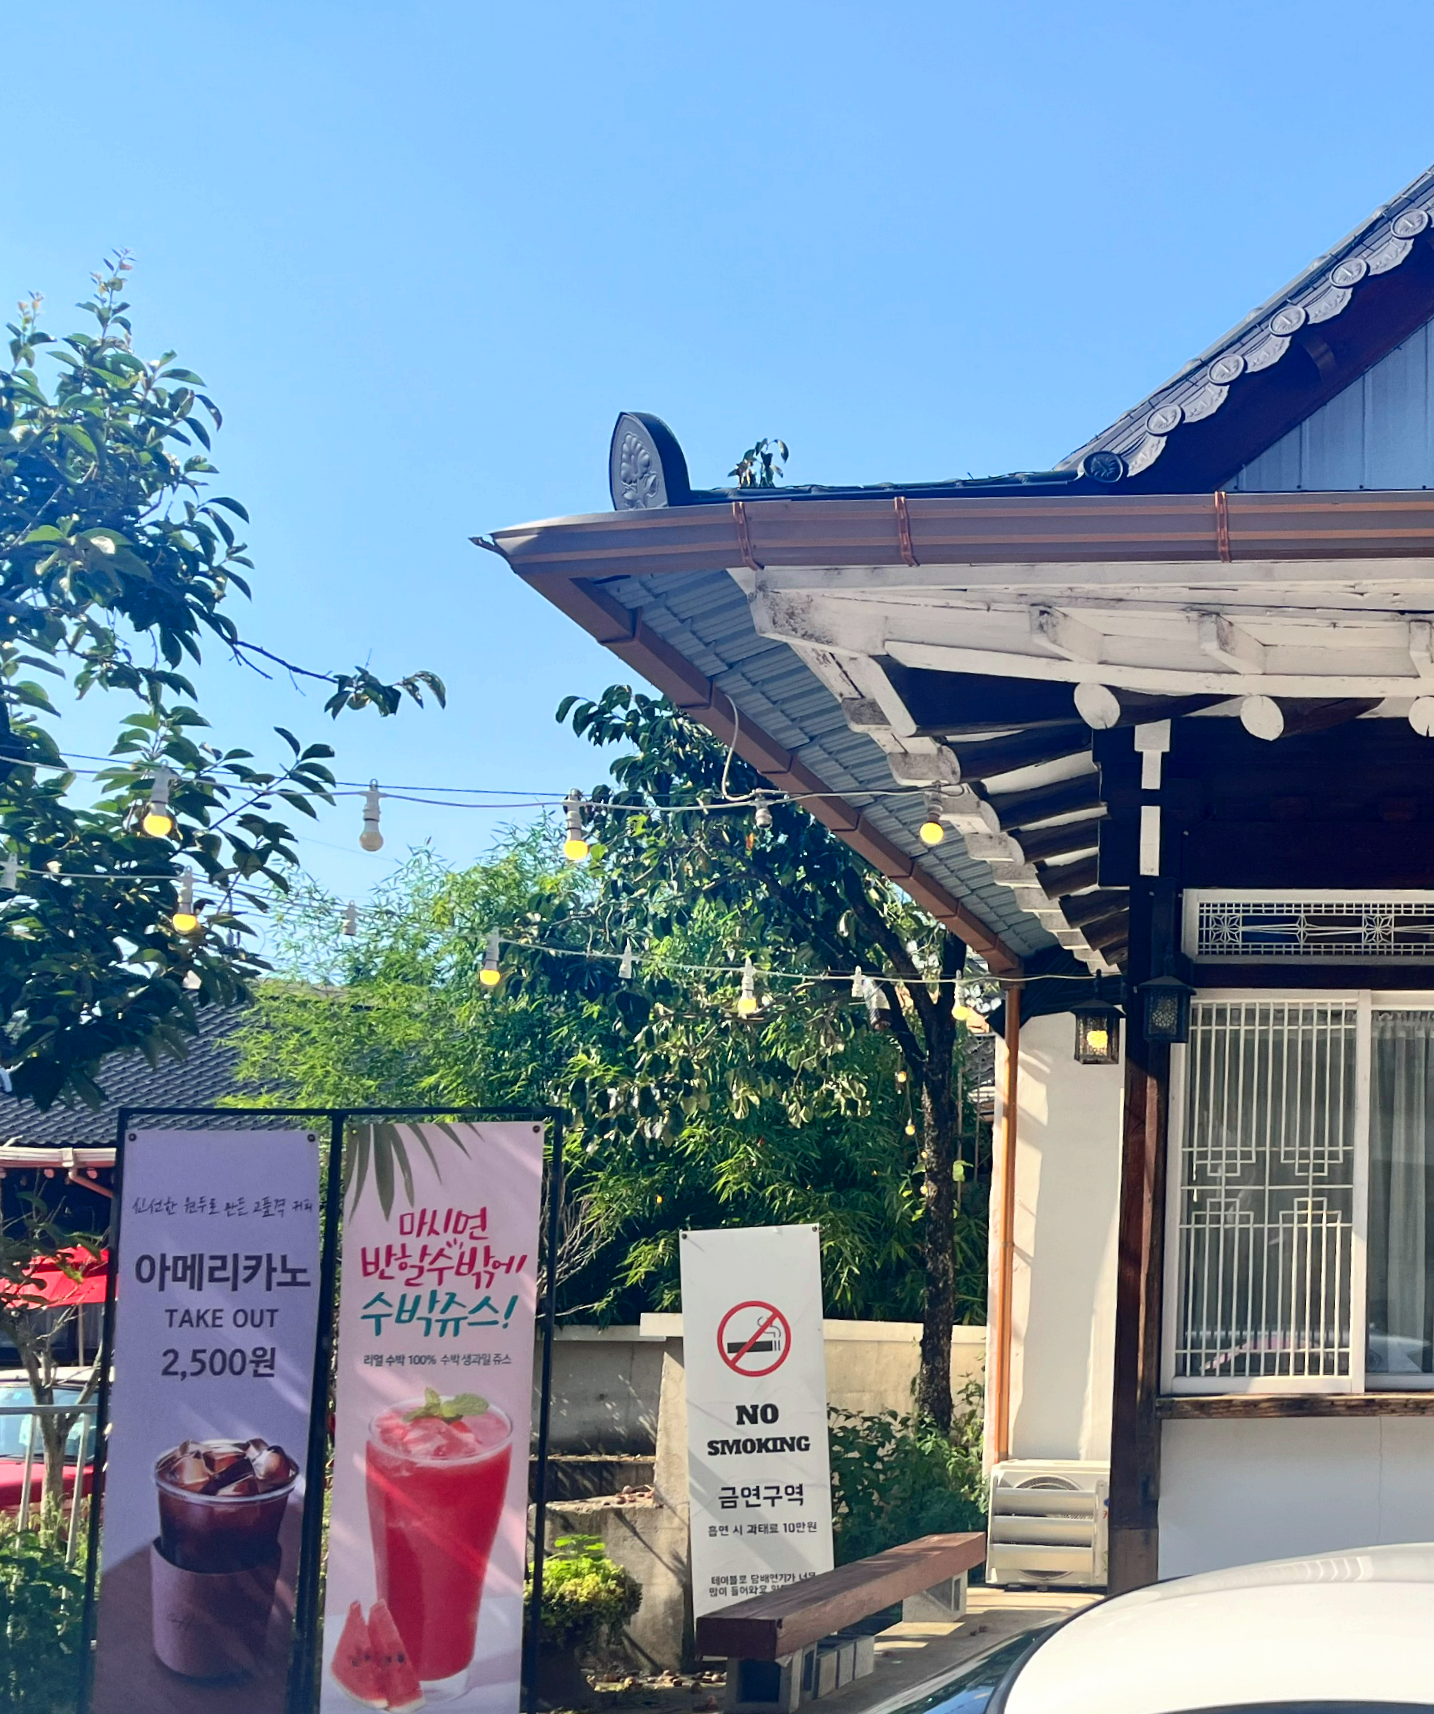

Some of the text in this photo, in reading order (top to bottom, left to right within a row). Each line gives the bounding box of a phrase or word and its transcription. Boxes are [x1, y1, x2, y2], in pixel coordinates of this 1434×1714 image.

[132, 1196, 178, 1216] 신선한
[183, 1195, 220, 1216] 원두로
[223, 1196, 249, 1217] 만든
[252, 1195, 286, 1218] 고품격
[399, 1206, 489, 1240] 마시면
[135, 1253, 311, 1292] 아메리카노
[165, 1308, 279, 1328] TAKE OUT
[360, 1289, 519, 1337] 수박쥬스!
[161, 1346, 277, 1381] 2,500원
[363, 1353, 512, 1367] 리얼 수박 100% 수박 생과일 쥬스
[736, 1403, 779, 1425] NO
[707, 1436, 811, 1456] SMOKING
[718, 1483, 804, 1509] 금연구역
[708, 1521, 818, 1537] 흡연 시 과태료 10만원
[711, 1575, 747, 1585] 테이블로
[750, 1573, 796, 1584] 담배연기가
[709, 1587, 728, 1597] 많이
